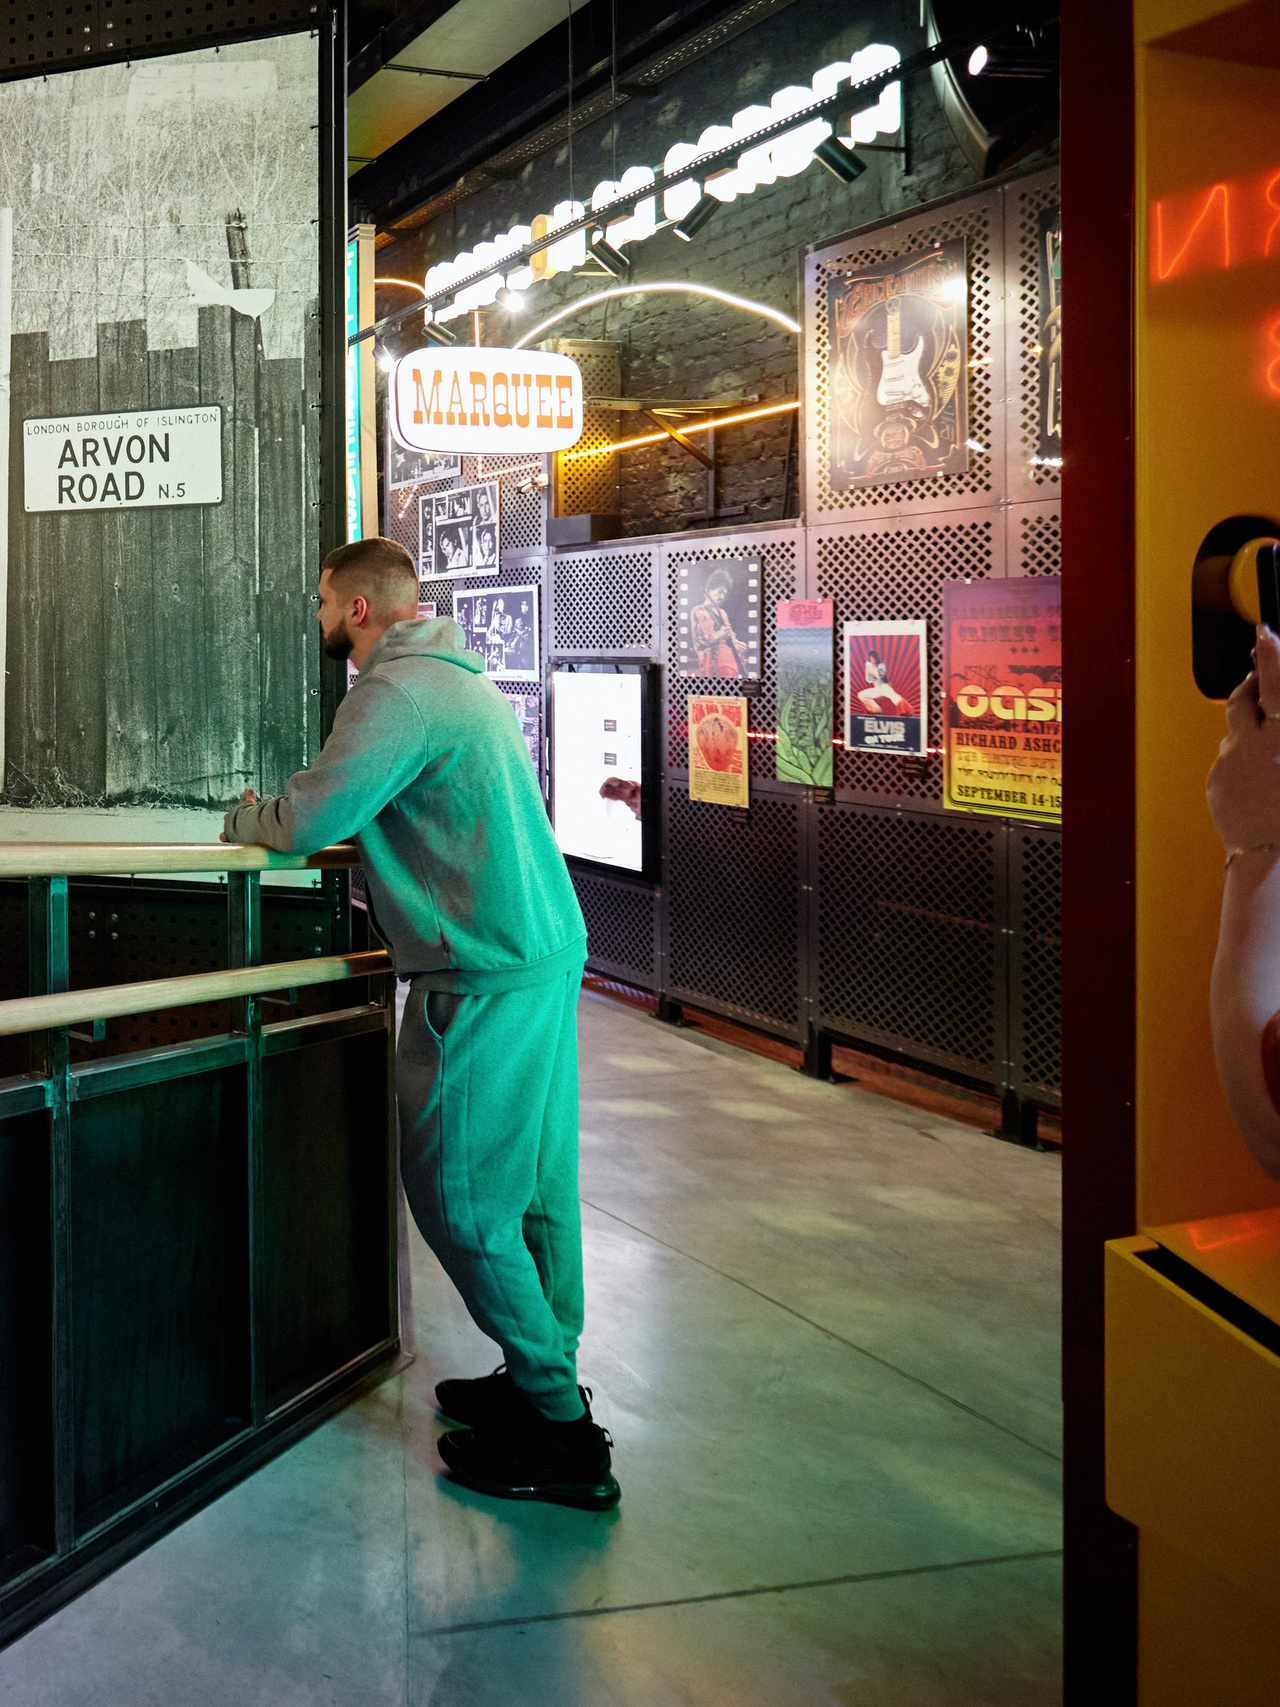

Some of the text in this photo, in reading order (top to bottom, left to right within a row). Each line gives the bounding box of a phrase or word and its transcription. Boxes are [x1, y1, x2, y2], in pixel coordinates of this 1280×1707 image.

[412, 368, 574, 429] MARQUEE
[27, 412, 218, 436] LONDON BOROUGH OF ISLINGTON
[57, 432, 170, 469] ARVON
[57, 471, 186, 504] ROAD N.5
[864, 719, 906, 735] ELVIS
[956, 732, 1017, 750] RICHARD
[957, 784, 1028, 805] SEPTEMBER
